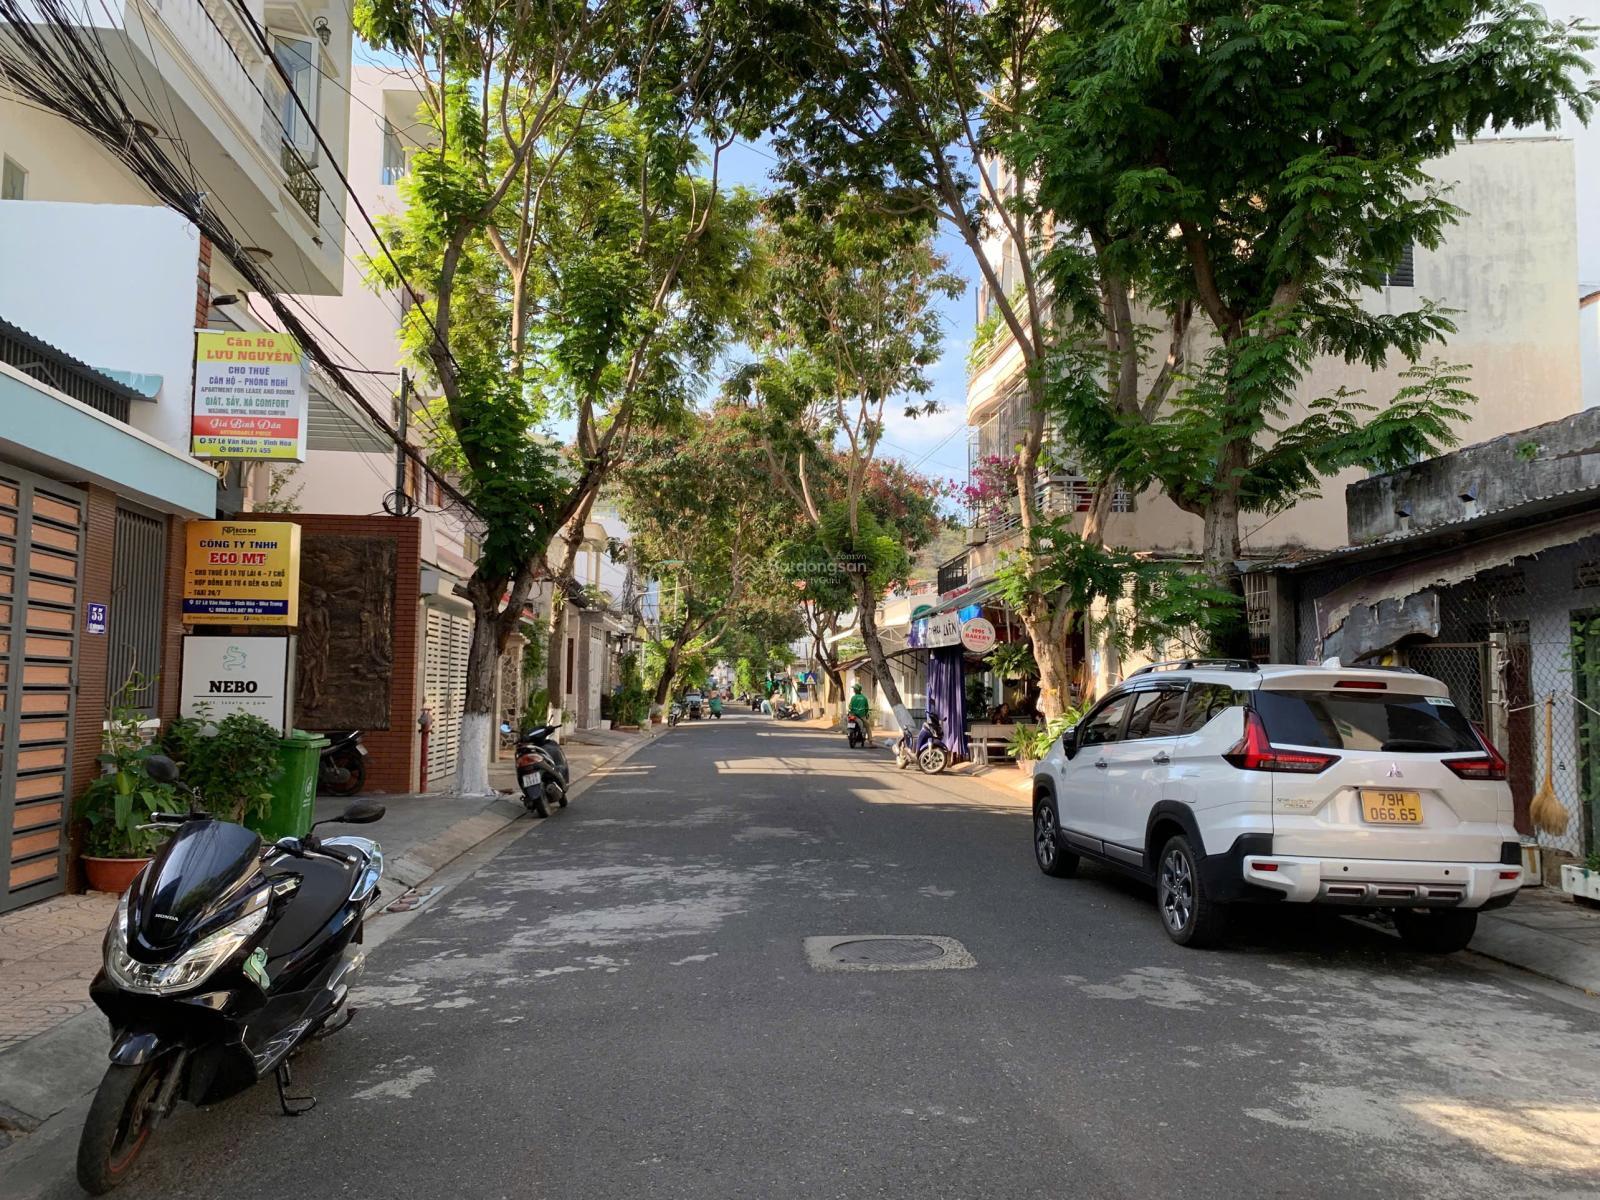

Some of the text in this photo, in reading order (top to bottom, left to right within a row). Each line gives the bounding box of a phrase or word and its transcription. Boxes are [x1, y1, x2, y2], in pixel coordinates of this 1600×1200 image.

[228, 366, 270, 375] CHO THUÊ
[200, 386, 233, 394] APARTMENT
[255, 398, 290, 408] COMFORT
[200, 539, 278, 550] CÔNG TY TNHH
[209, 552, 267, 566] ECO MT
[92, 606, 104, 622] 55
[965, 632, 991, 641] BAKERY
[208, 680, 258, 694] NEBO
[1378, 793, 1405, 807] 79H
[1370, 808, 1417, 821] 066.65
[154, 913, 179, 922] HONDA
